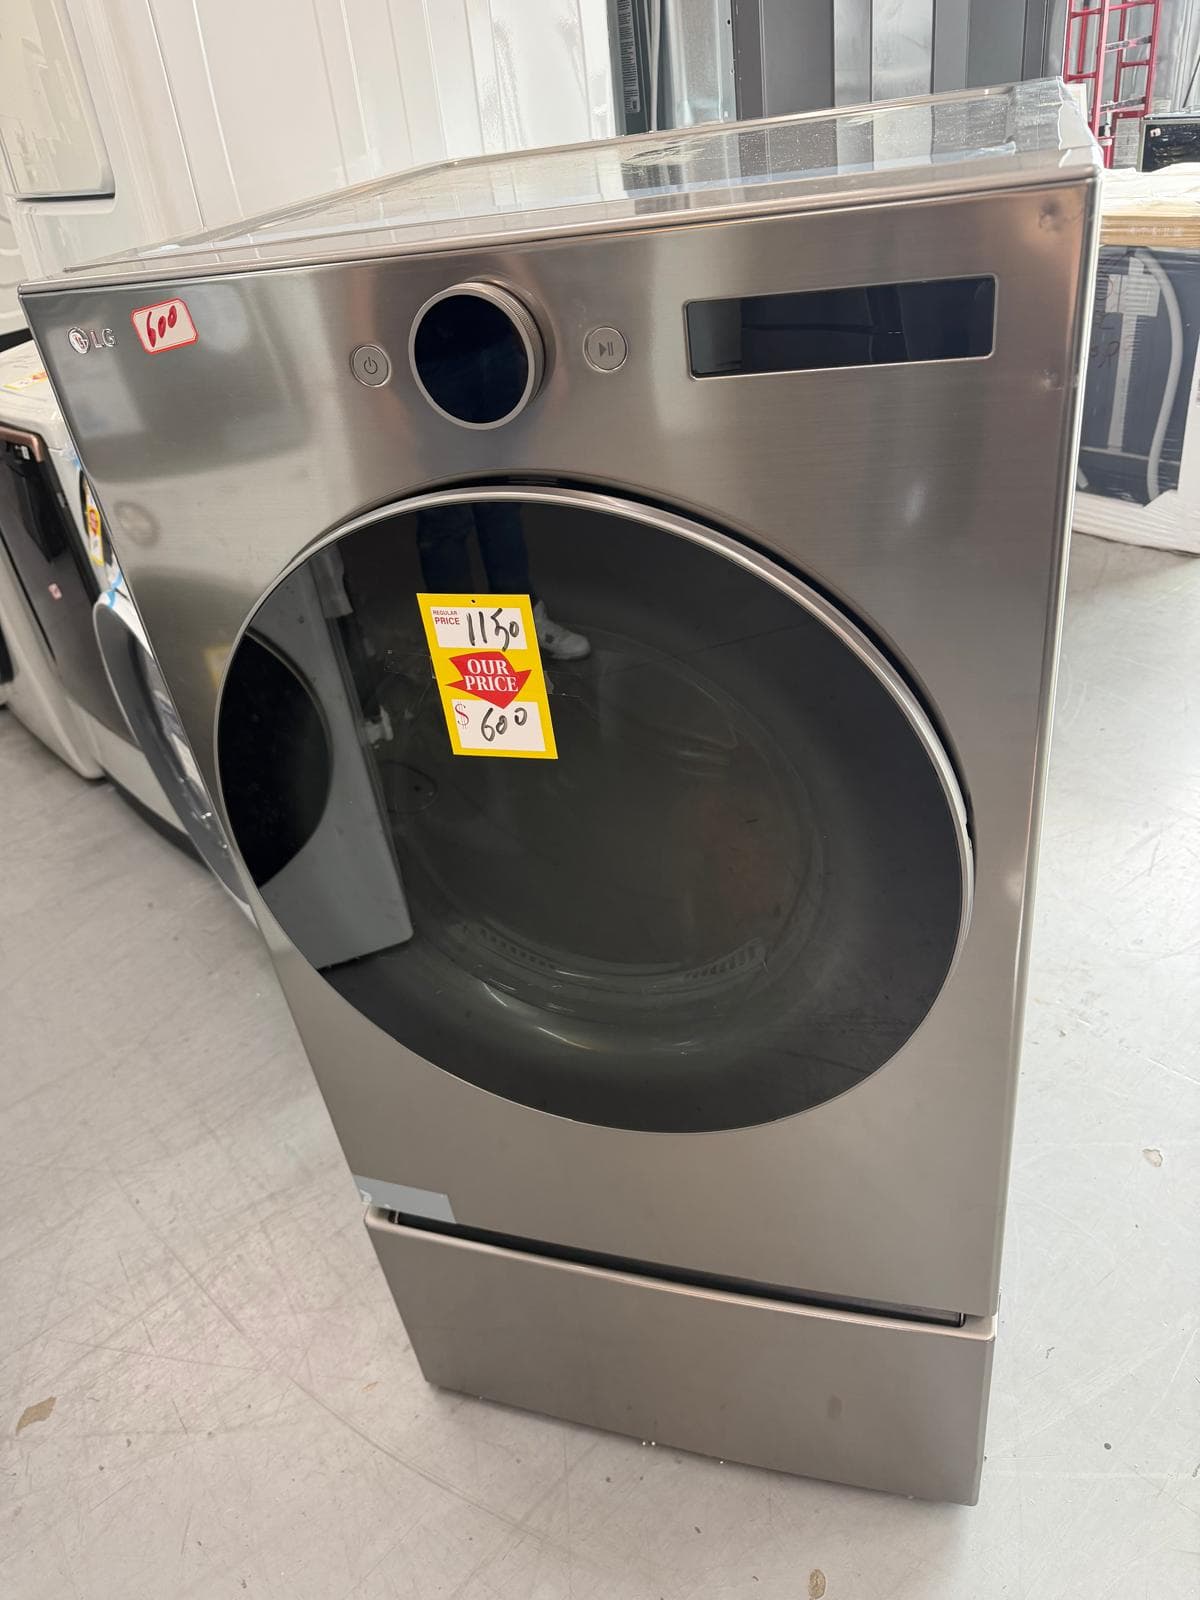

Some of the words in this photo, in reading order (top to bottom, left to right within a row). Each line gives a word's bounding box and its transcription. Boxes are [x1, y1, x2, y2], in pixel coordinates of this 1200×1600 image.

[146, 304, 178, 348] 600
[89, 328, 116, 348] LG
[434, 616, 461, 625] PRICE
[466, 607, 520, 652] 1150
[467, 658, 510, 676] OUR
[464, 675, 519, 692] PRICE
[454, 702, 470, 729] $
[481, 707, 528, 742] 600
